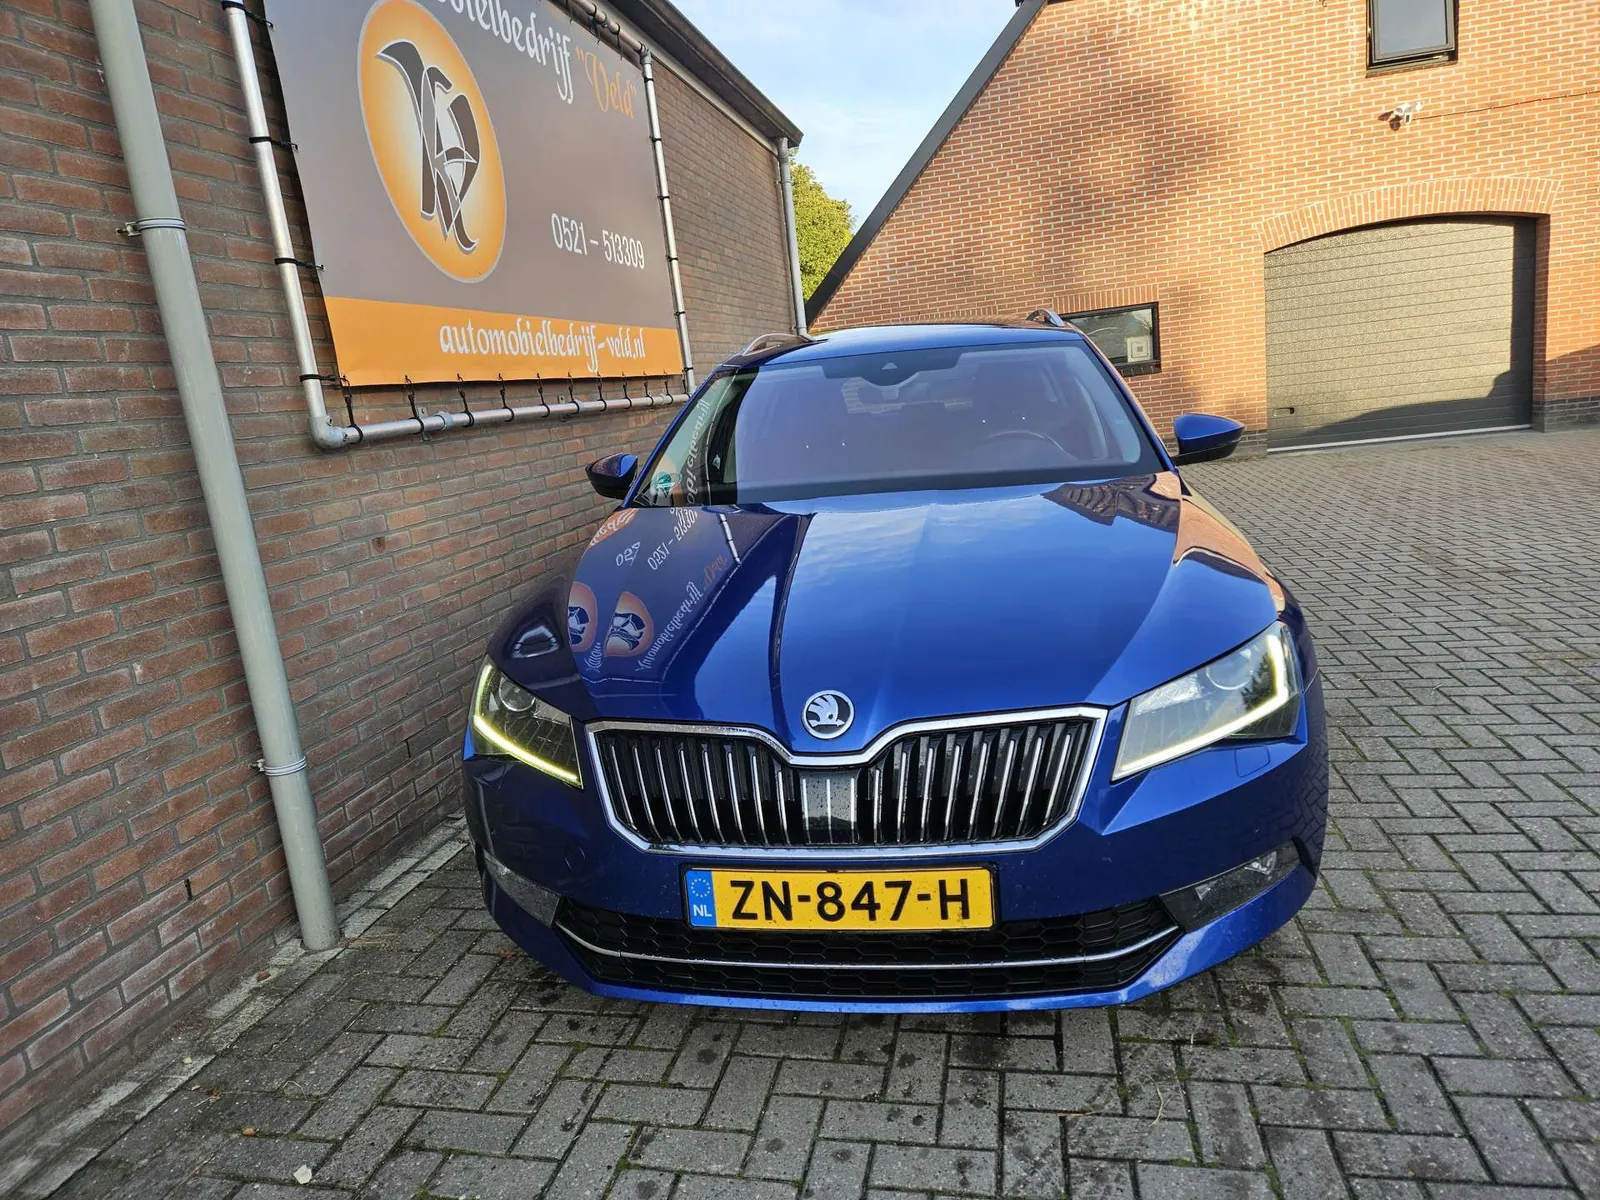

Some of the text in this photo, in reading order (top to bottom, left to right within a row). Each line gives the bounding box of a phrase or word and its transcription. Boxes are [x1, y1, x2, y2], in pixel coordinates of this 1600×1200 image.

[438, 0, 575, 104] elbedrijf
[551, 212, 587, 255] 0521
[602, 229, 645, 269] 513309
[439, 317, 646, 373] automobielbedrijf-veld.nl
[692, 904, 713, 917] NL
[730, 878, 970, 922] ZN-847-H
